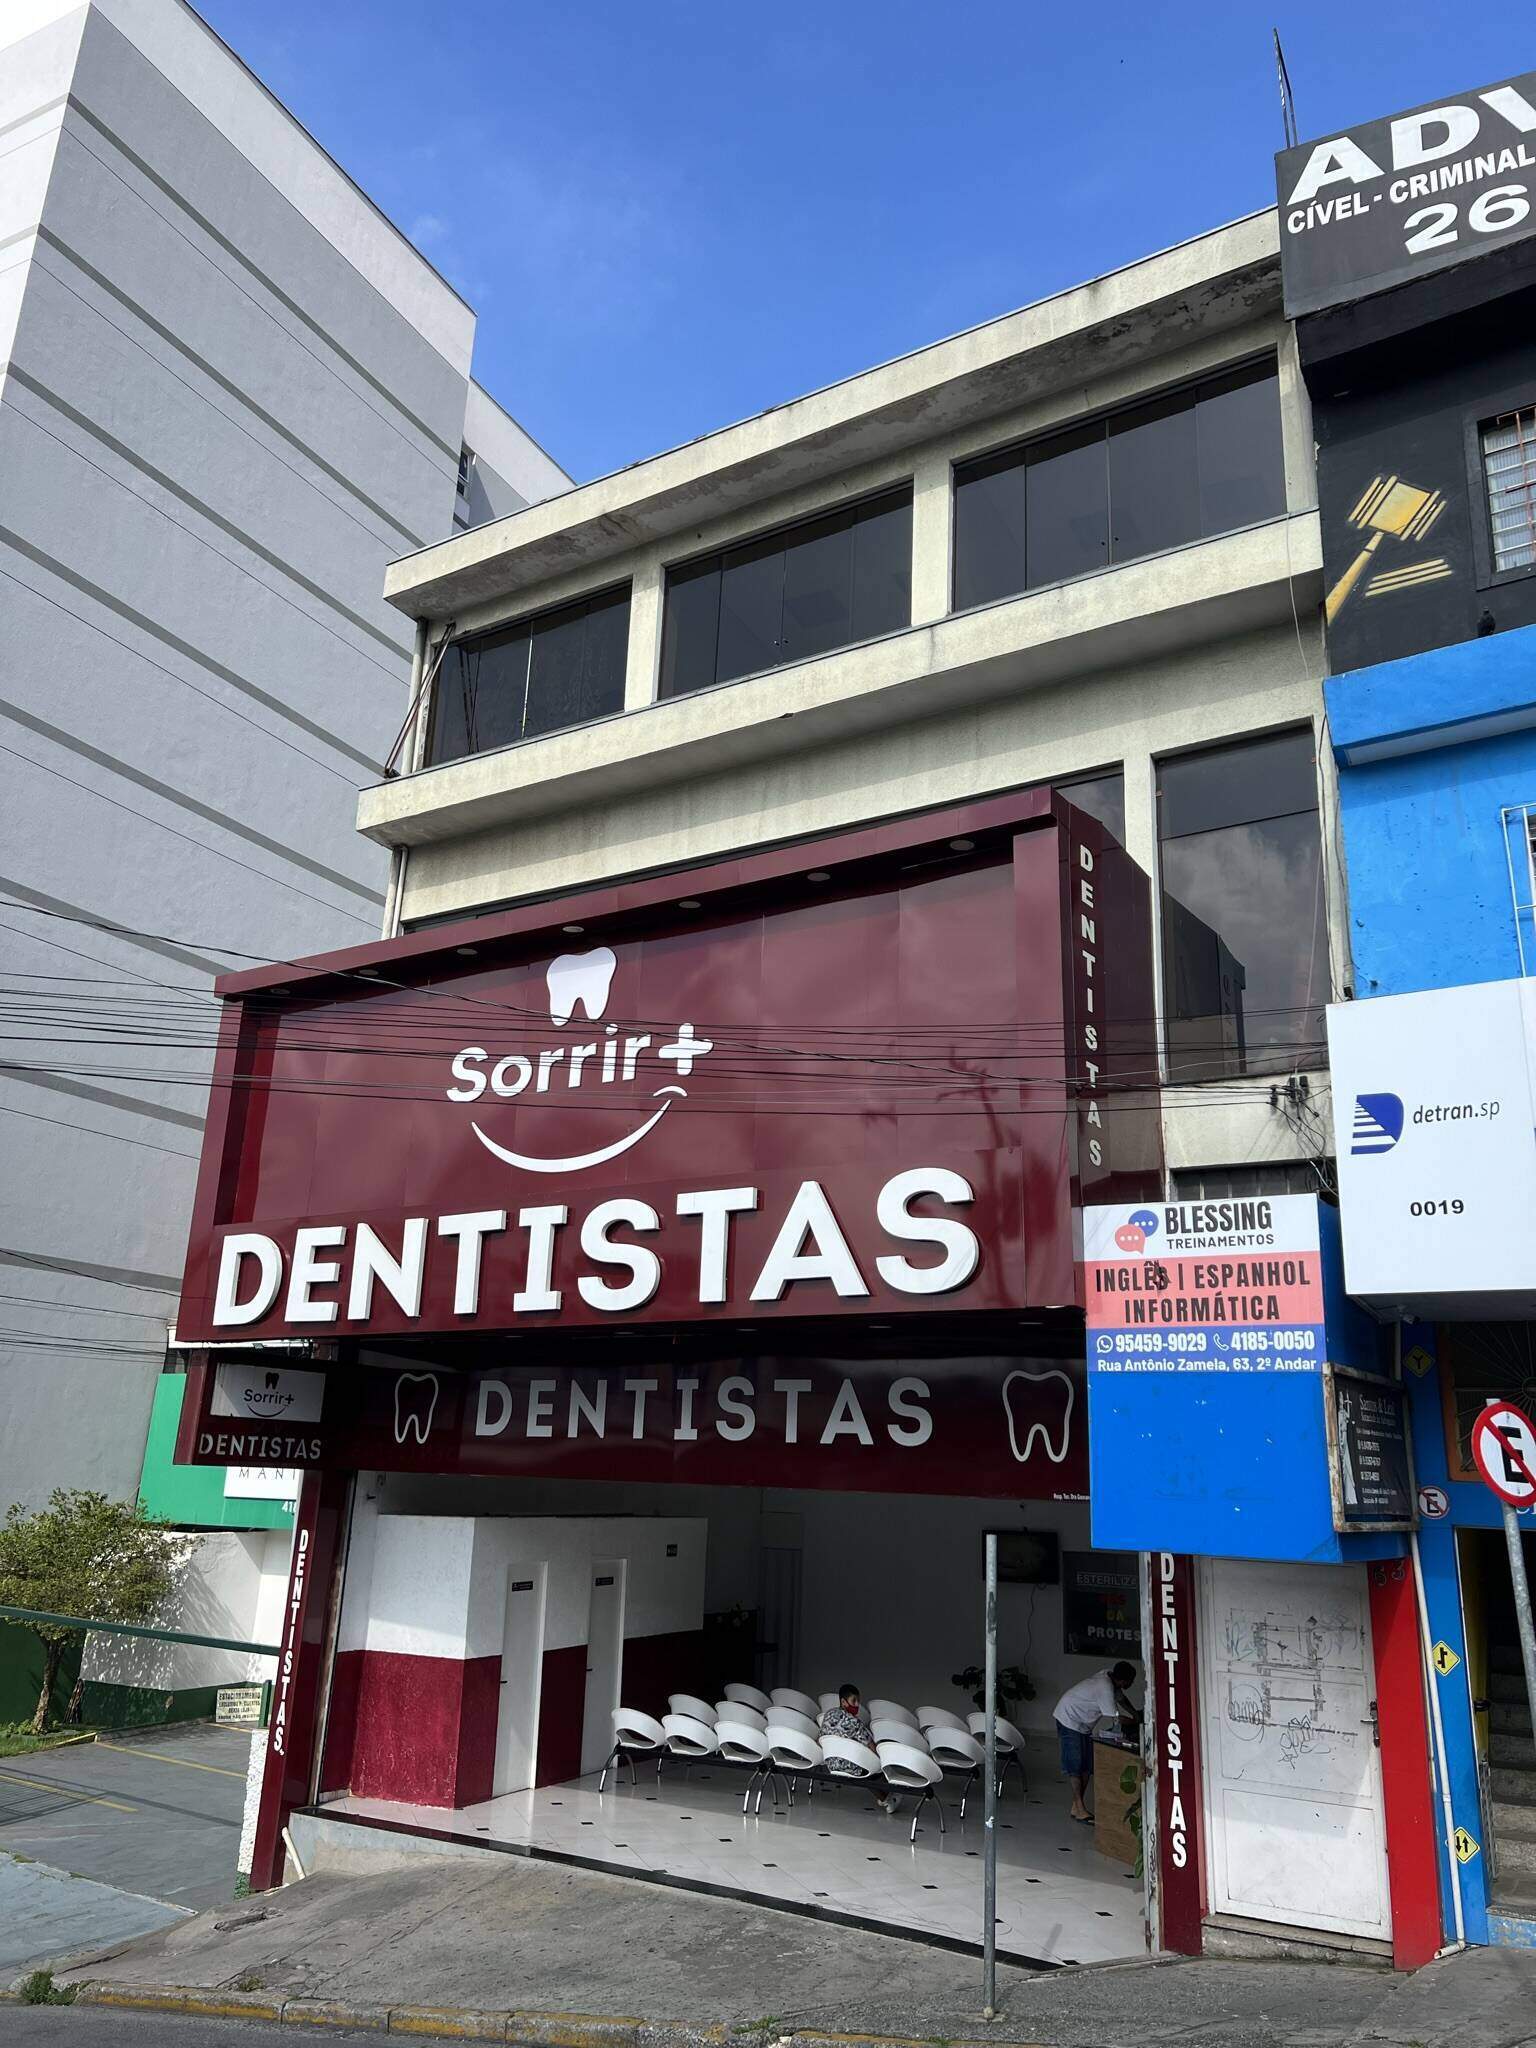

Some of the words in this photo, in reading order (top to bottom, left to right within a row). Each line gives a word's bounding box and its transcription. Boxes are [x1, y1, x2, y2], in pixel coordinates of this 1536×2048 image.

[1287, 192, 1370, 234] CÍVEL
[1389, 144, 1536, 204] CRIMINAL
[1403, 184, 1531, 255] 26
[1080, 844, 1103, 1168] DENTISTAS
[1413, 1101, 1501, 1124] detran.sp
[1165, 1201, 1272, 1235] BLESSING
[1410, 1199, 1465, 1216] 0019
[213, 1167, 980, 1327] DENTISTAS
[1166, 1233, 1275, 1250] TREINAMENTOS
[1096, 1260, 1169, 1292] INGLÊS
[1195, 1260, 1311, 1290] ESPANHOL
[1125, 1291, 1281, 1324] INFORMÁTICA
[1115, 1333, 1208, 1353] 95459-9029
[1231, 1330, 1316, 1351] 4185-0050
[1098, 1359, 1122, 1372] Rua
[1124, 1357, 1175, 1372] Antônio
[1232, 1357, 1254, 1372] 63,
[1274, 1357, 1317, 1371] Andar
[475, 1376, 934, 1447] DENTISTAS
[198, 1433, 322, 1460] DENTISTAS
[274, 1529, 309, 1752] DENTISTAS
[1161, 1553, 1187, 1868] DENTISTAS
